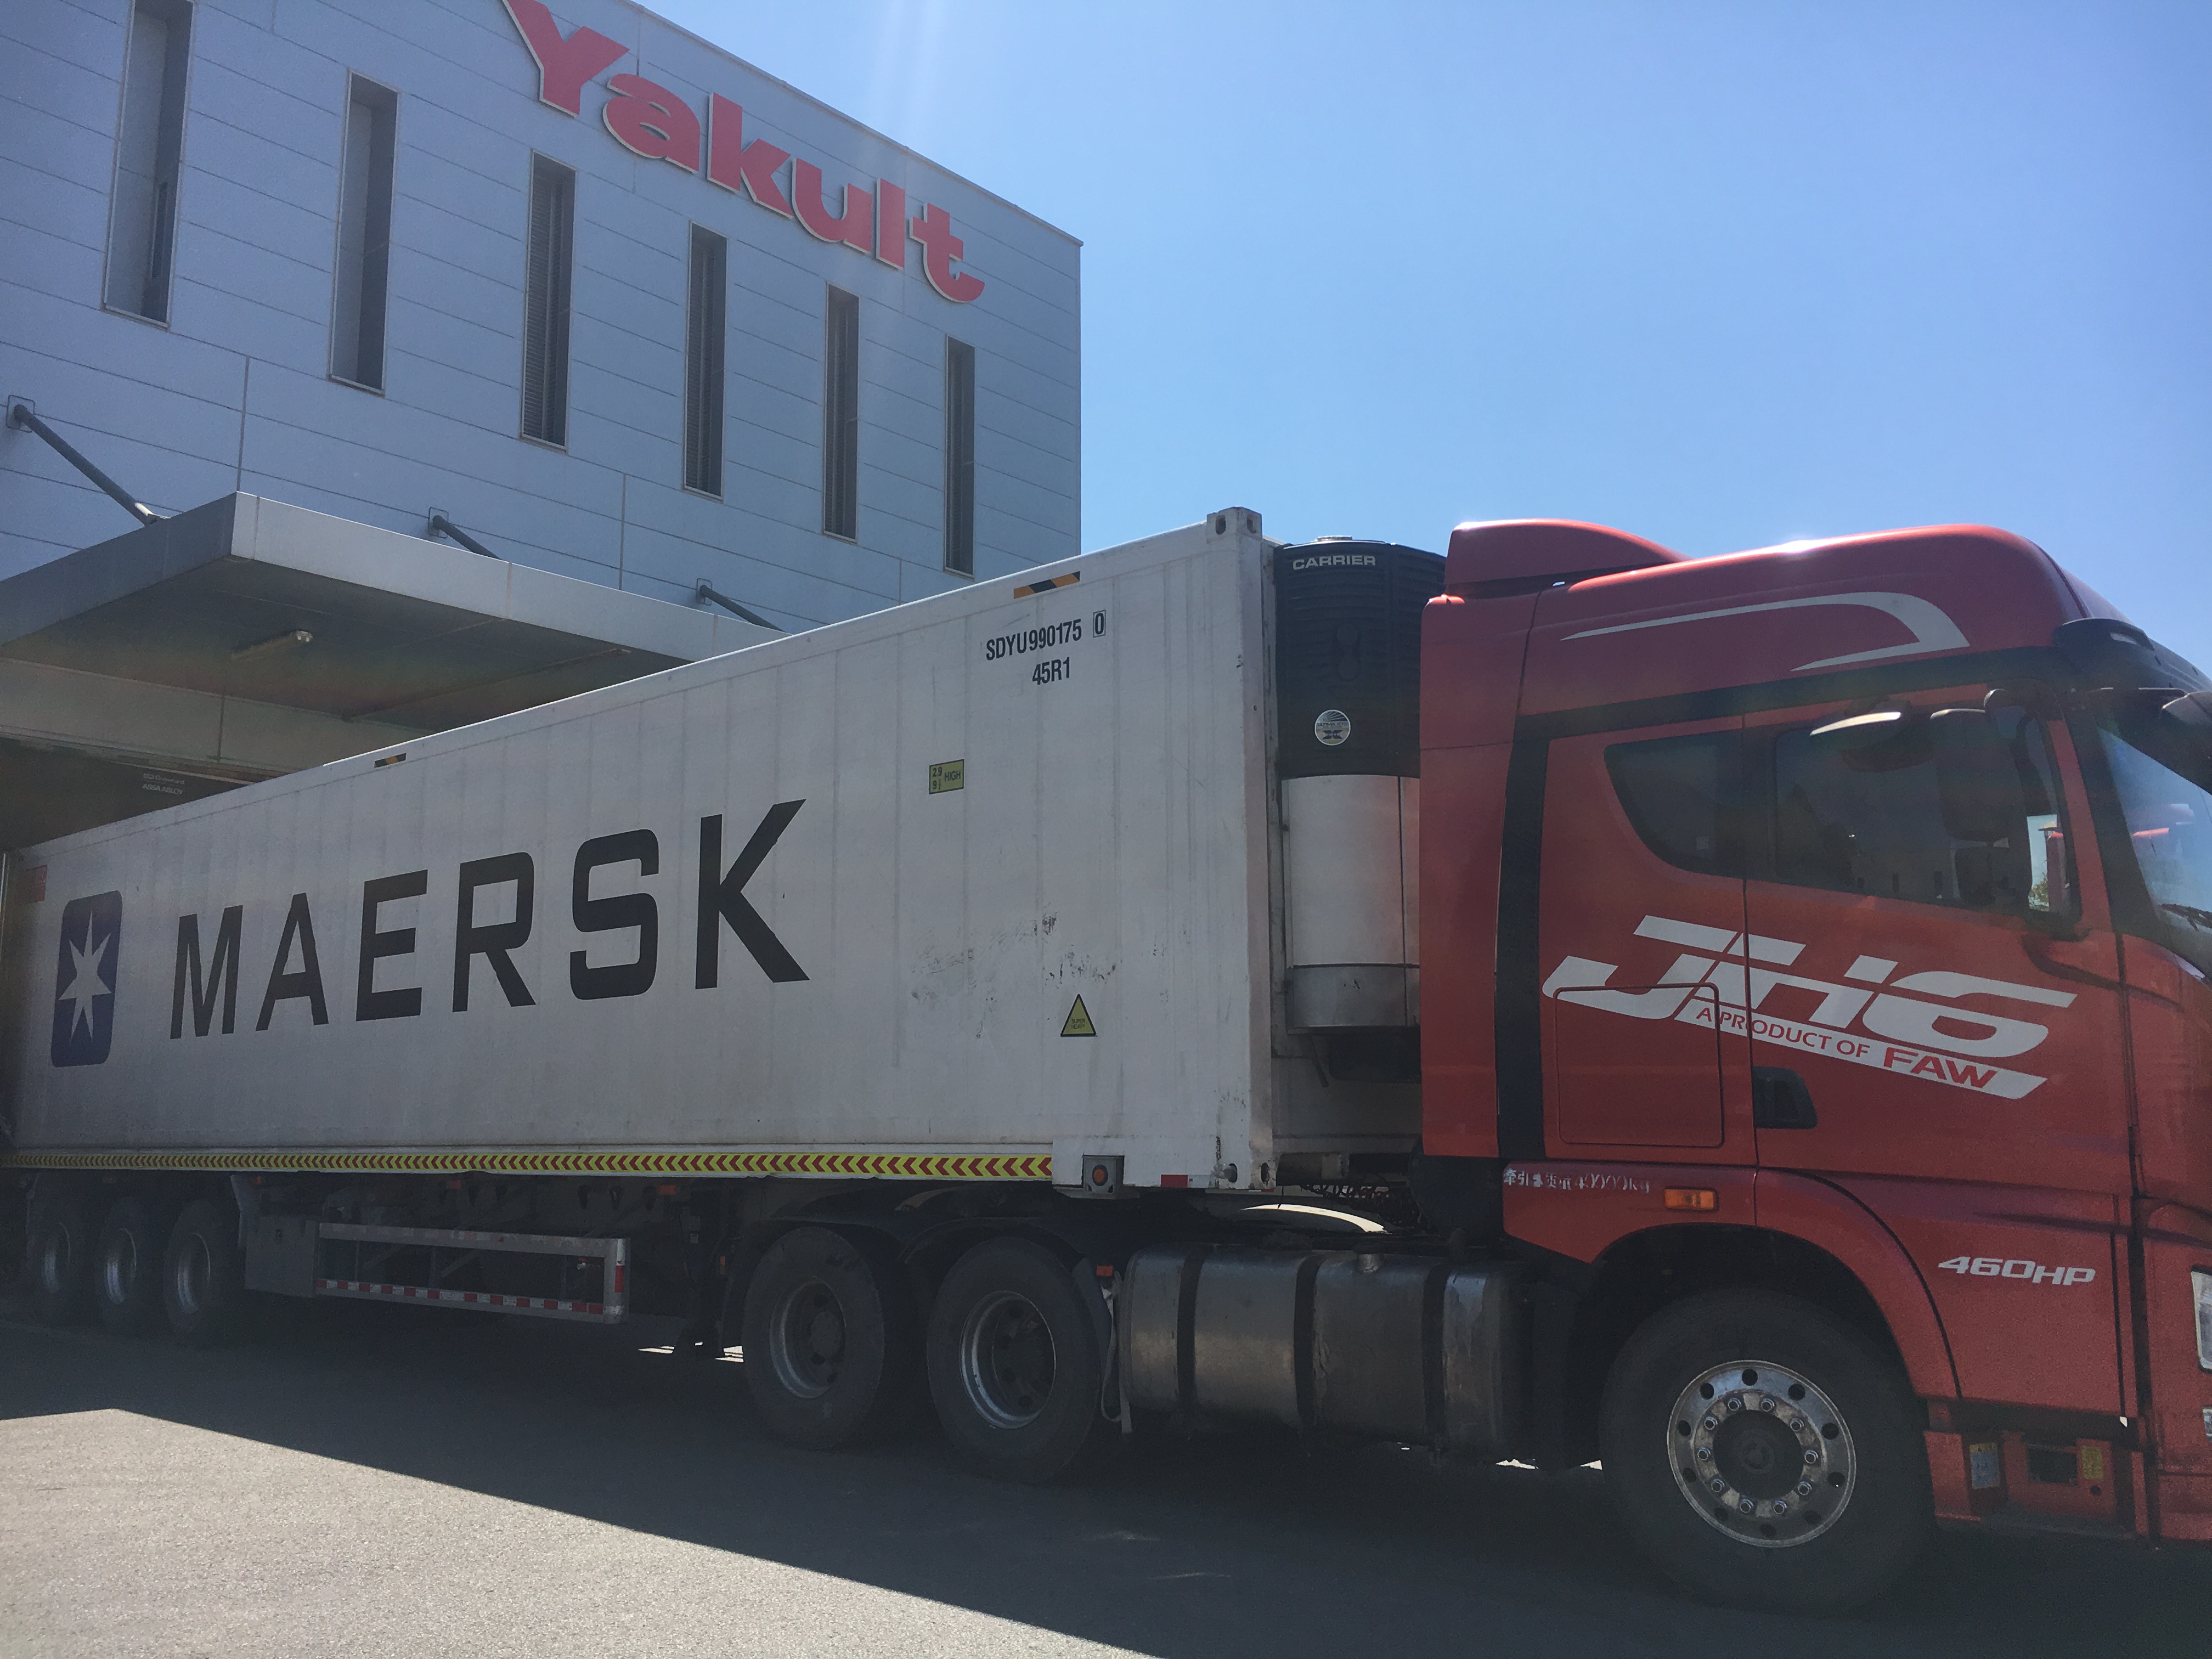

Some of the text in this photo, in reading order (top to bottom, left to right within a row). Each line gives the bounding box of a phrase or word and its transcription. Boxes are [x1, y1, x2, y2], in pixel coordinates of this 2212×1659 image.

[503, 0, 985, 303] Yakult
[1293, 555, 1376, 571] CARRIER
[1032, 657, 1070, 685] 45R1
[142, 783, 161, 792] ASSA
[944, 770, 961, 782] HIGH
[170, 799, 810, 1040] MAERSK
[1696, 1007, 1997, 1089] A PRODUCT OF FAW
[1938, 1256, 2096, 1285] 460HP
